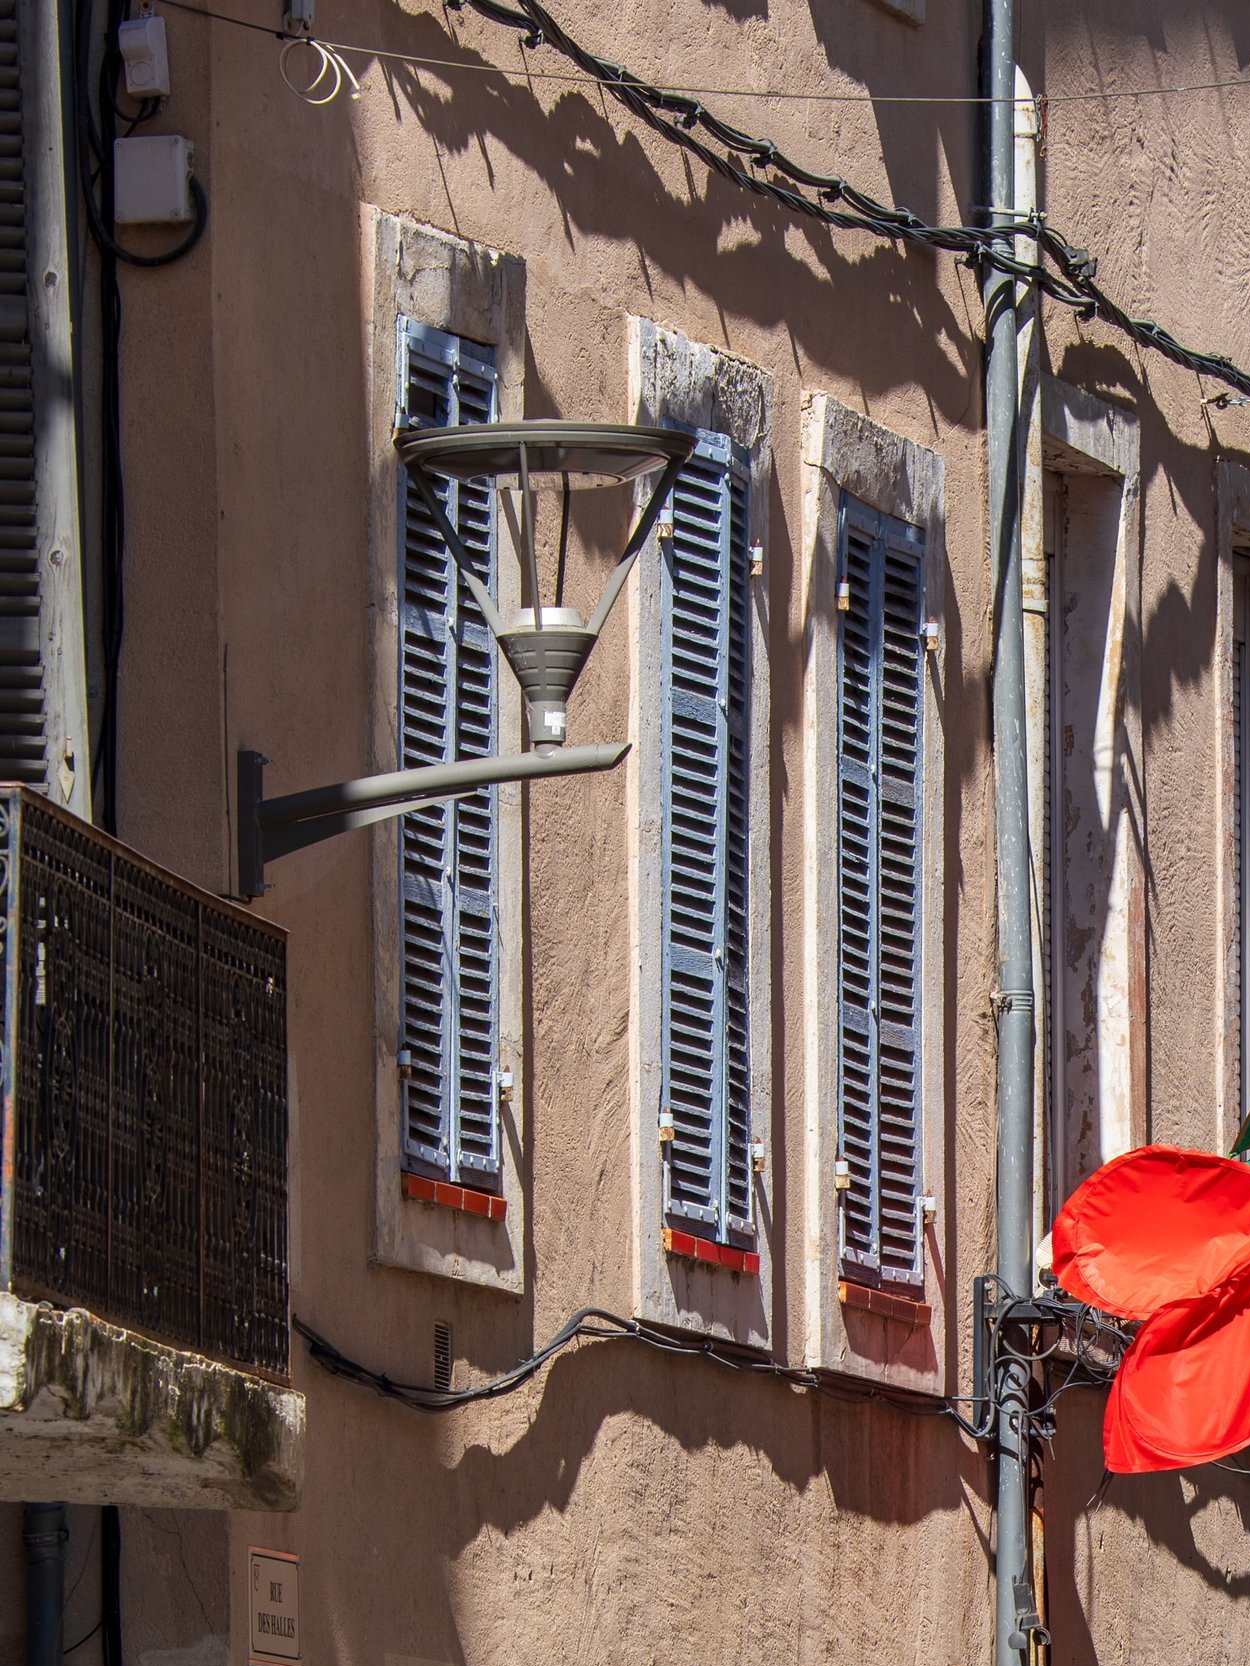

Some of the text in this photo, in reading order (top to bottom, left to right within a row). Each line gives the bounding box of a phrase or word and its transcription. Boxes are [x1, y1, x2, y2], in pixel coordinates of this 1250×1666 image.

[269, 1581, 283, 1603] RUE
[257, 1612, 295, 1639] DES HALLES
